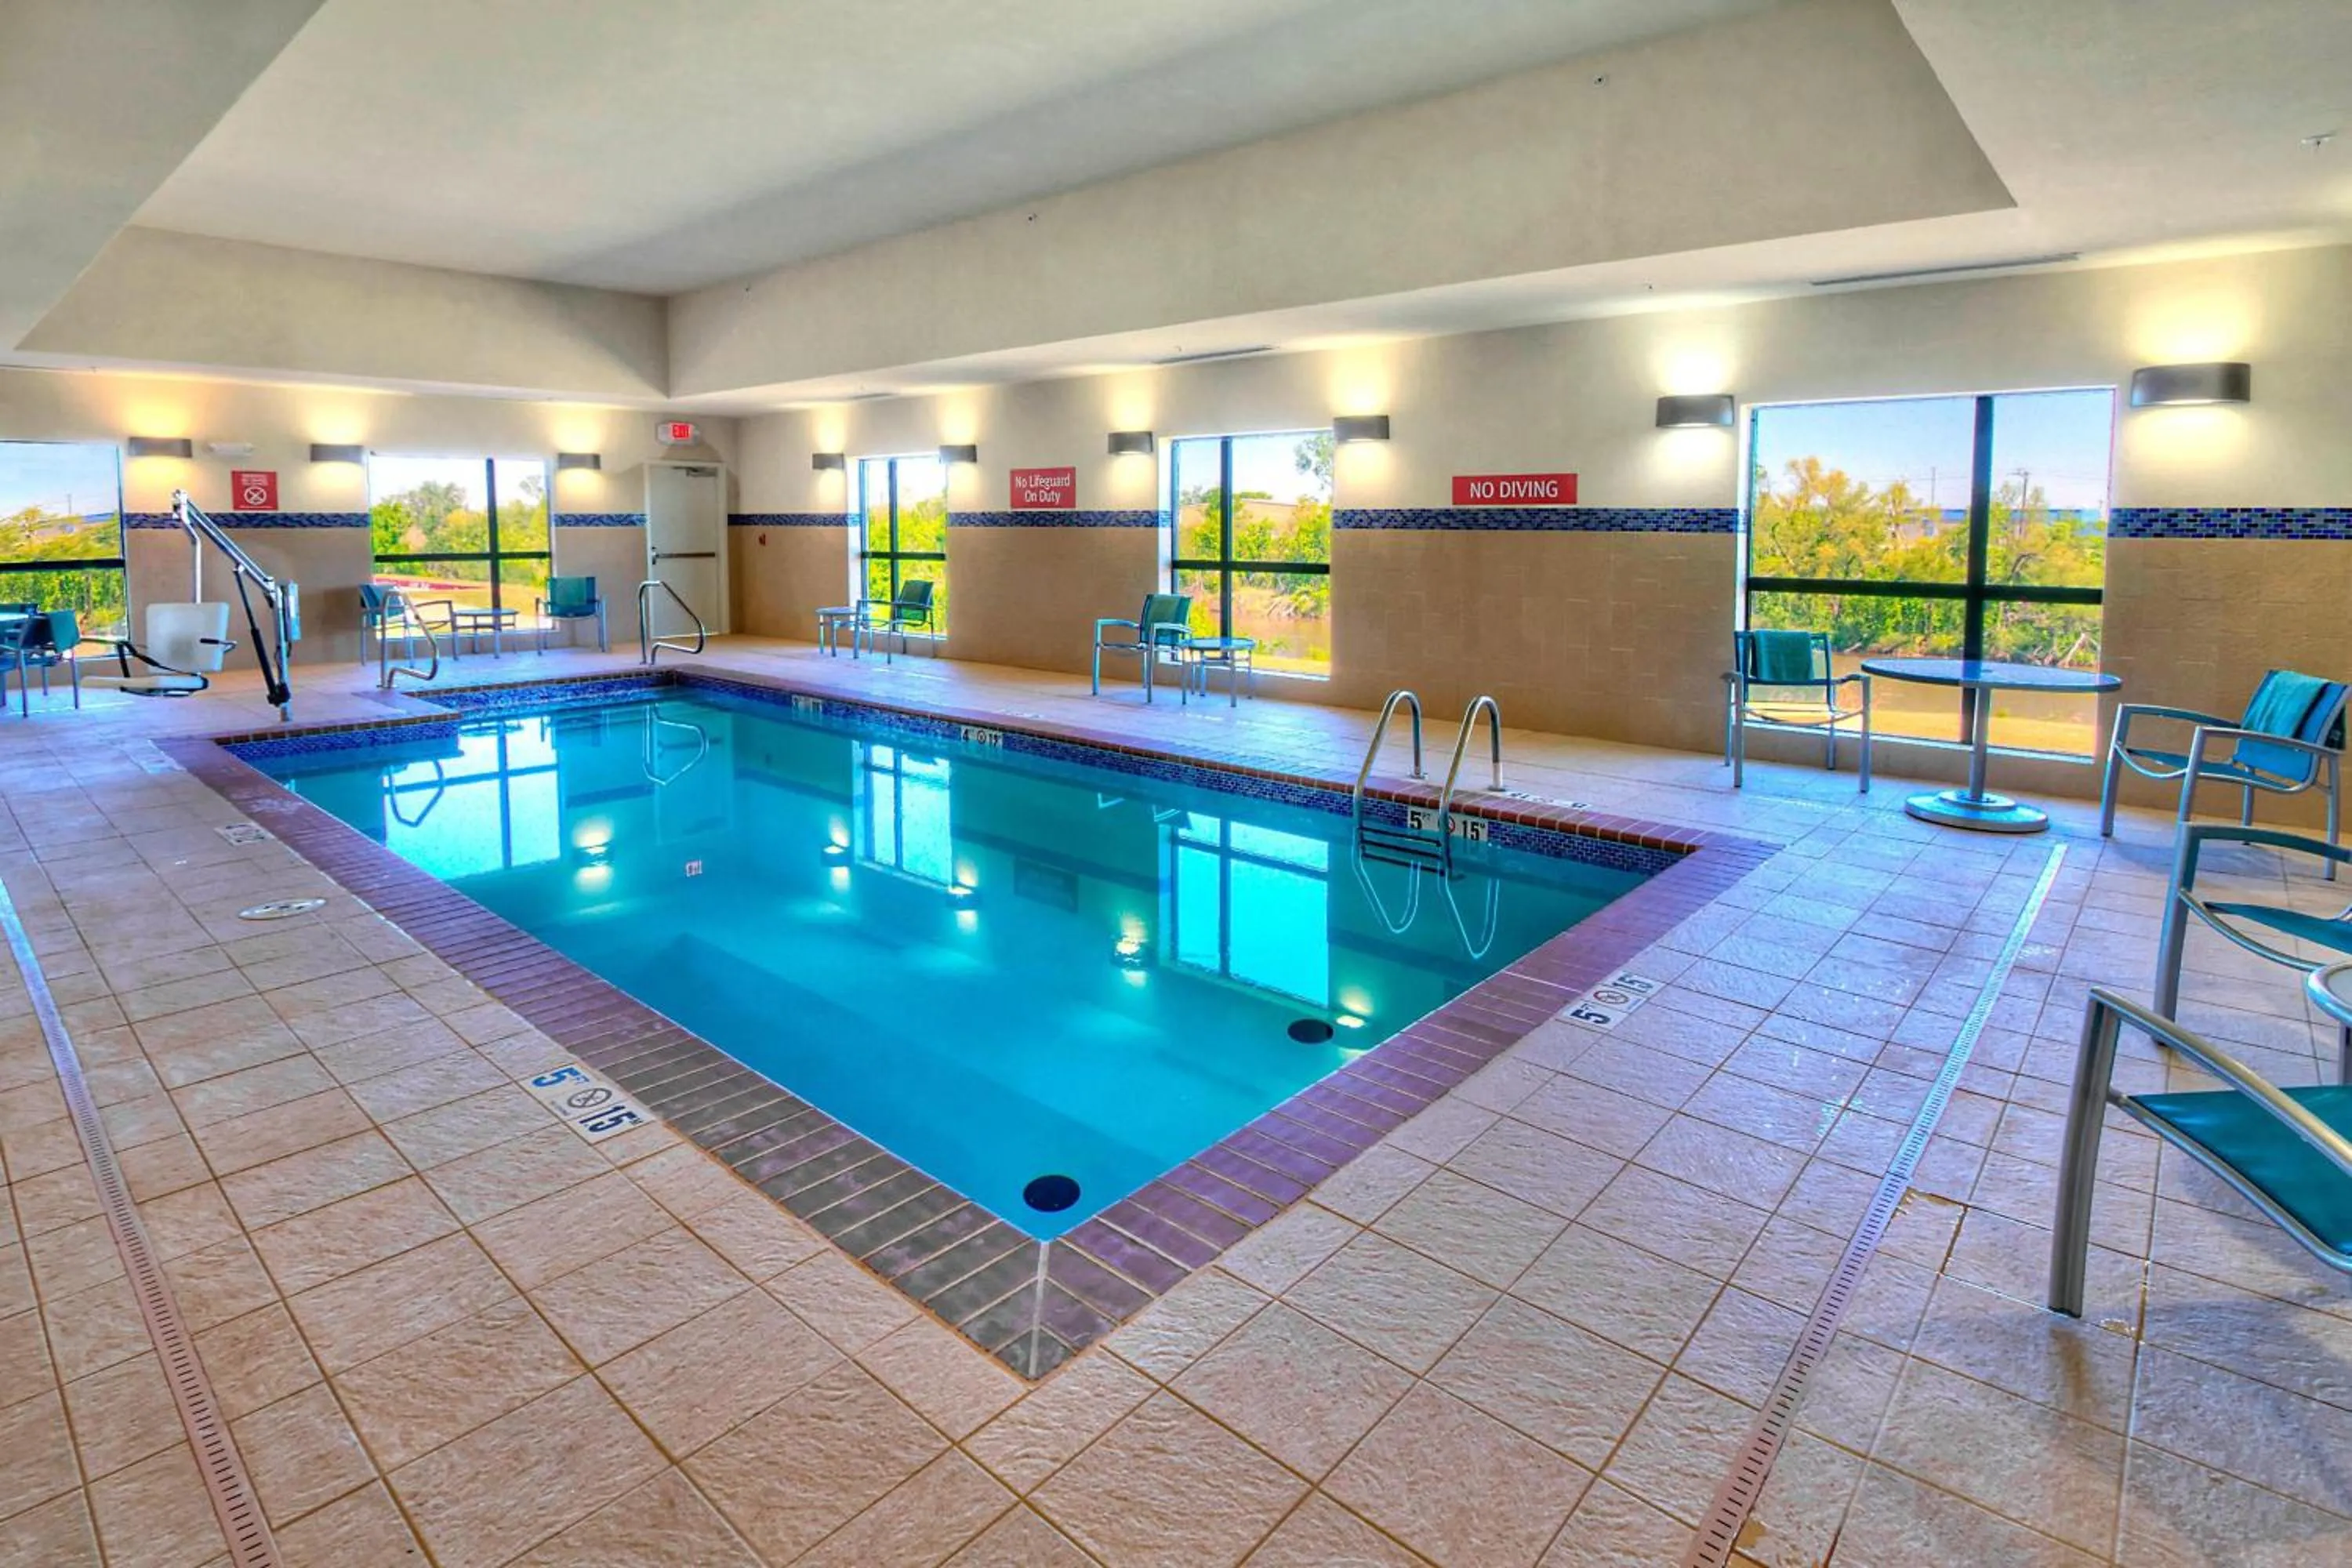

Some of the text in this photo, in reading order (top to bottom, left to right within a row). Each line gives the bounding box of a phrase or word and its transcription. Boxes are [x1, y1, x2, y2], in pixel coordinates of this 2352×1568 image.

[1015, 473, 1070, 490] No Lifeguard
[1470, 480, 1559, 499] NO DIVING
[1025, 489, 1061, 505] On Duty
